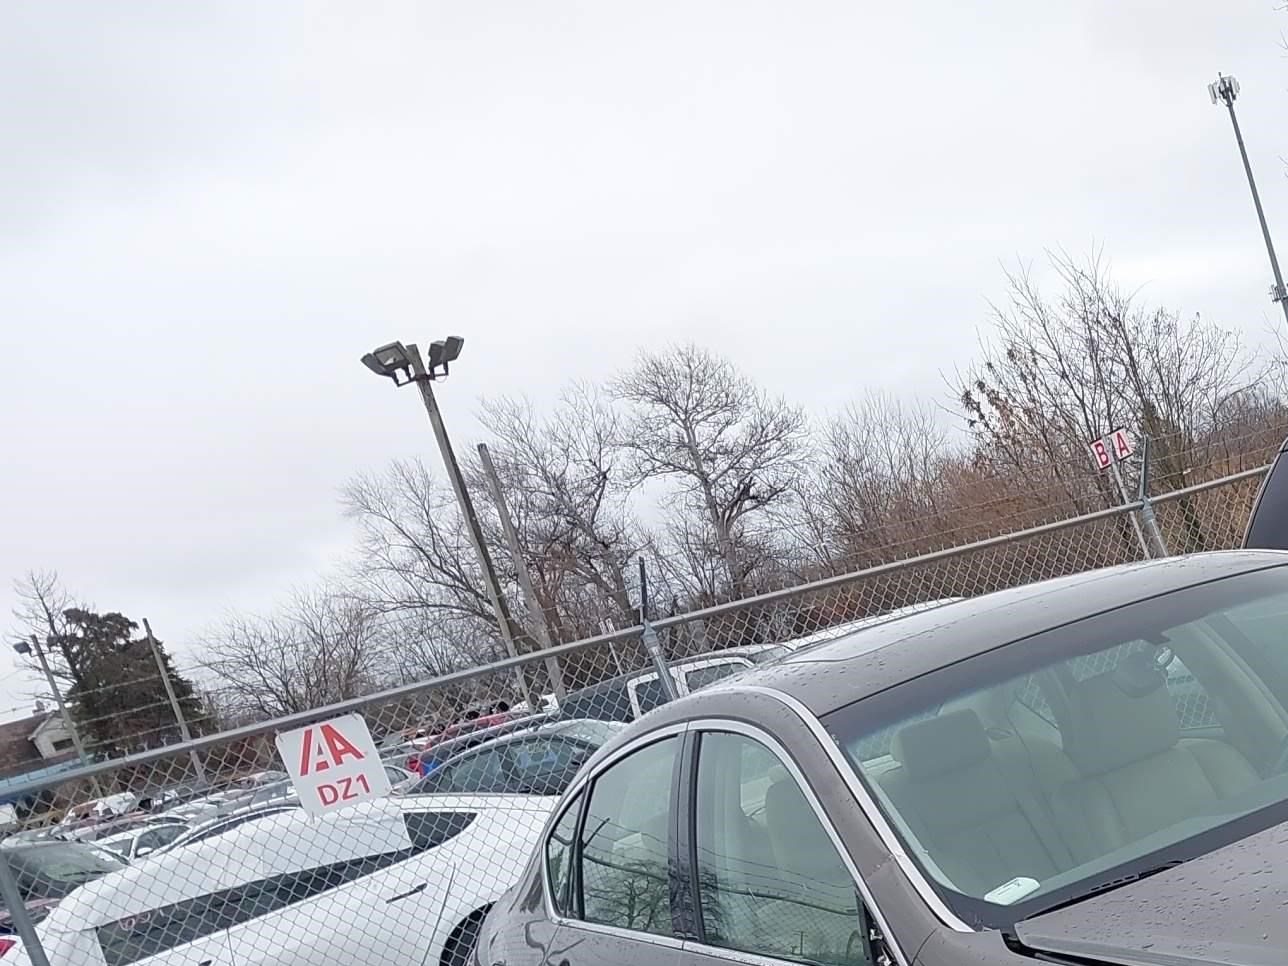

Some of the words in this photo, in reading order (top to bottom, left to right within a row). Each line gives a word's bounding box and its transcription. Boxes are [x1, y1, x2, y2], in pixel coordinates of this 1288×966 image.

[1094, 442, 1109, 466] B
[1116, 432, 1130, 457] A
[317, 774, 370, 807] DZ1
